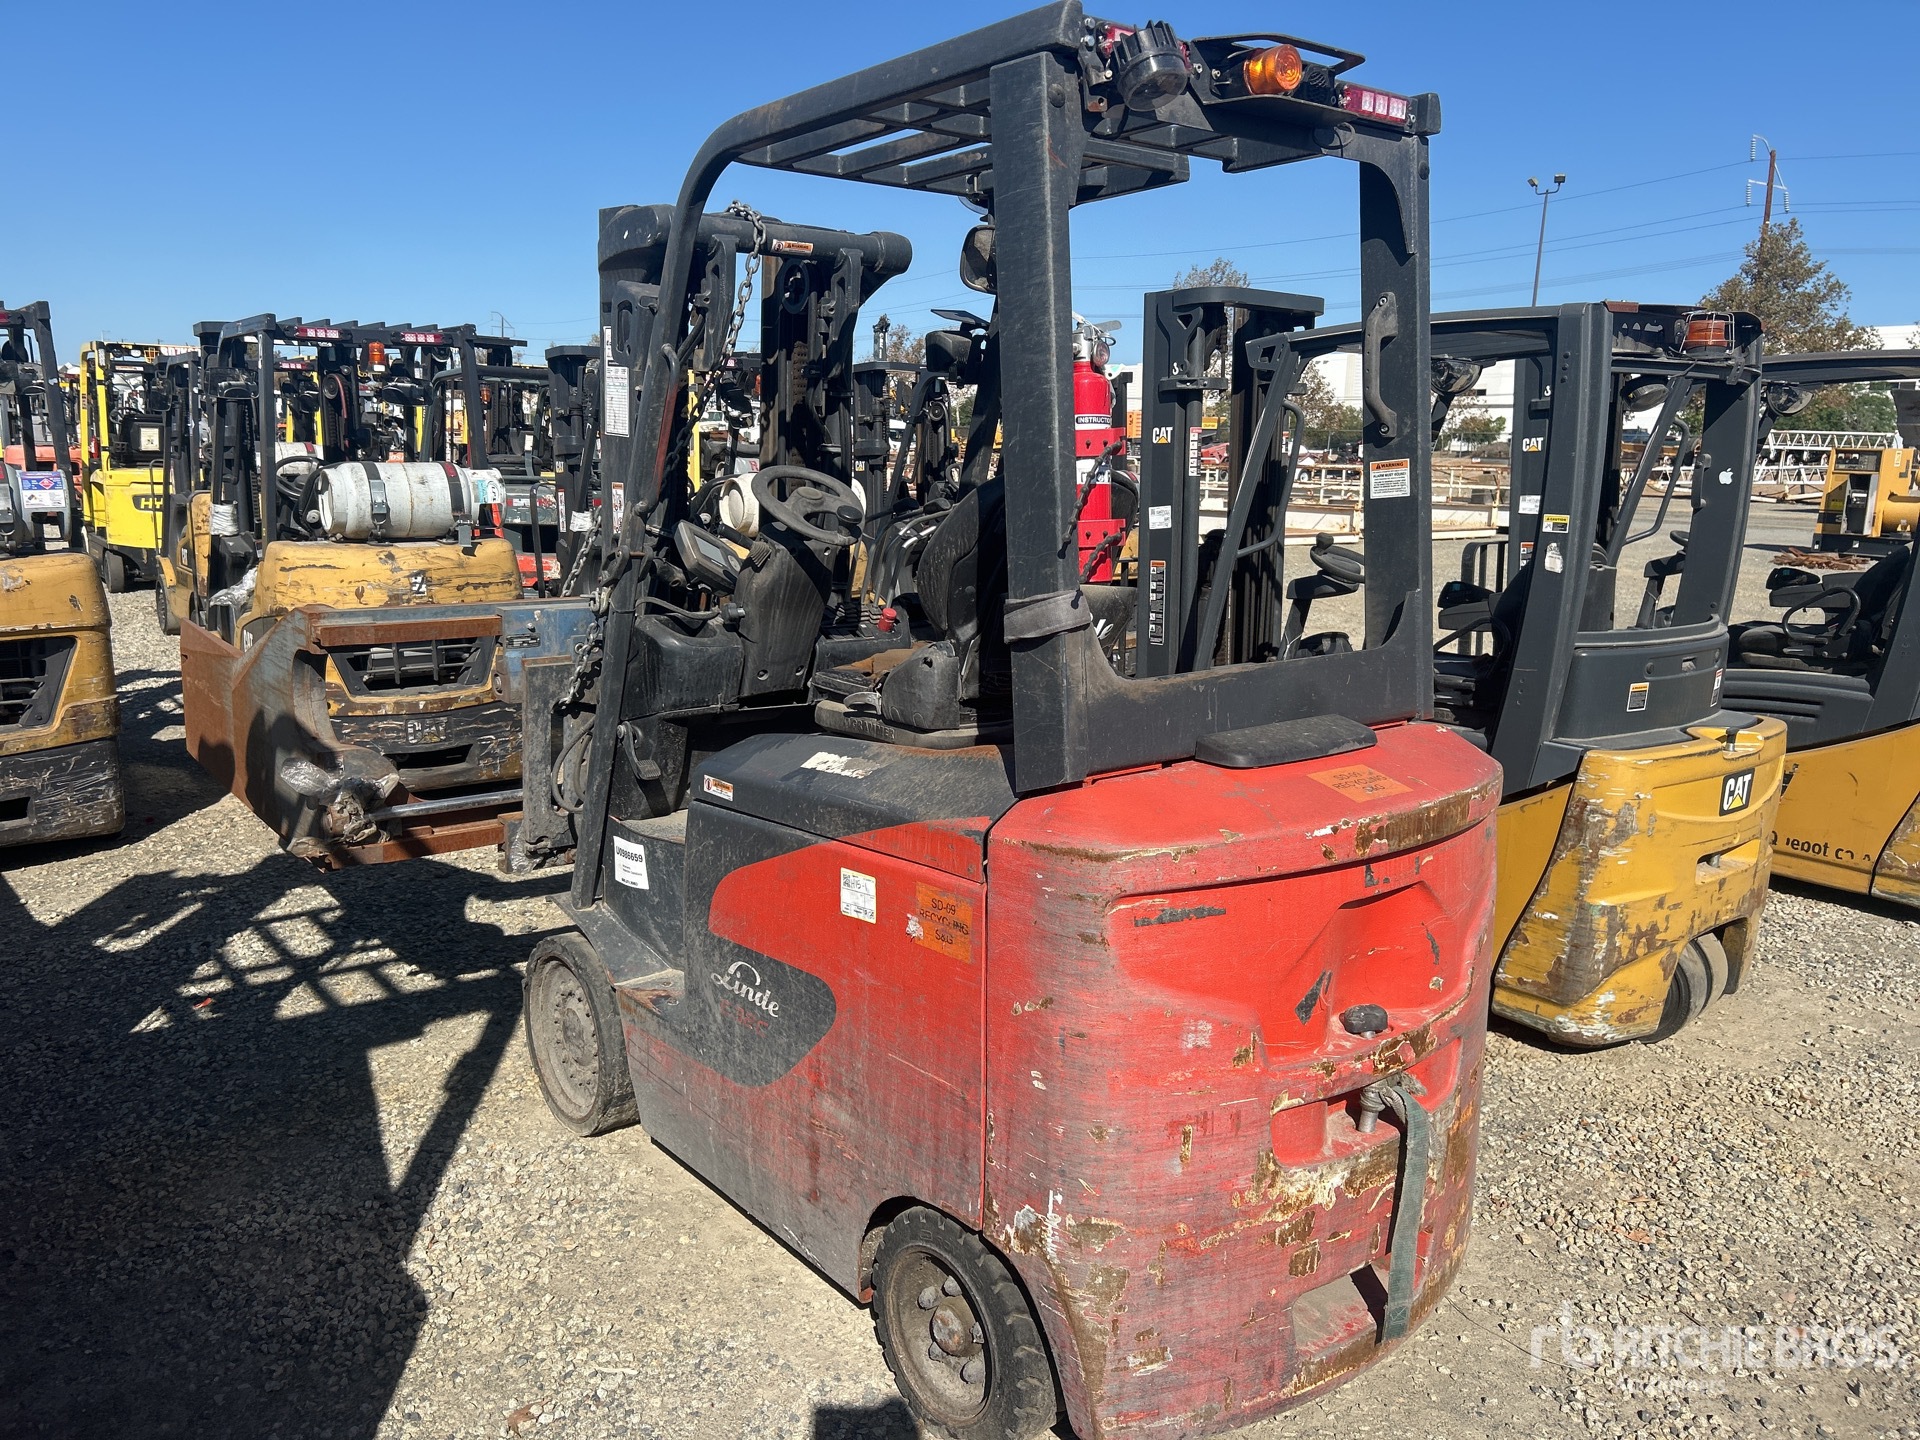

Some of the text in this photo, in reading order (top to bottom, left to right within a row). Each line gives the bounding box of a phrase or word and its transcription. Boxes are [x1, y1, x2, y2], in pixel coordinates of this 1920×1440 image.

[1152, 426, 1174, 444] CAT
[1522, 437, 1544, 452] CAT
[407, 717, 448, 744] CAT
[1722, 773, 1753, 811] CAT
[711, 961, 780, 1018] Linde
